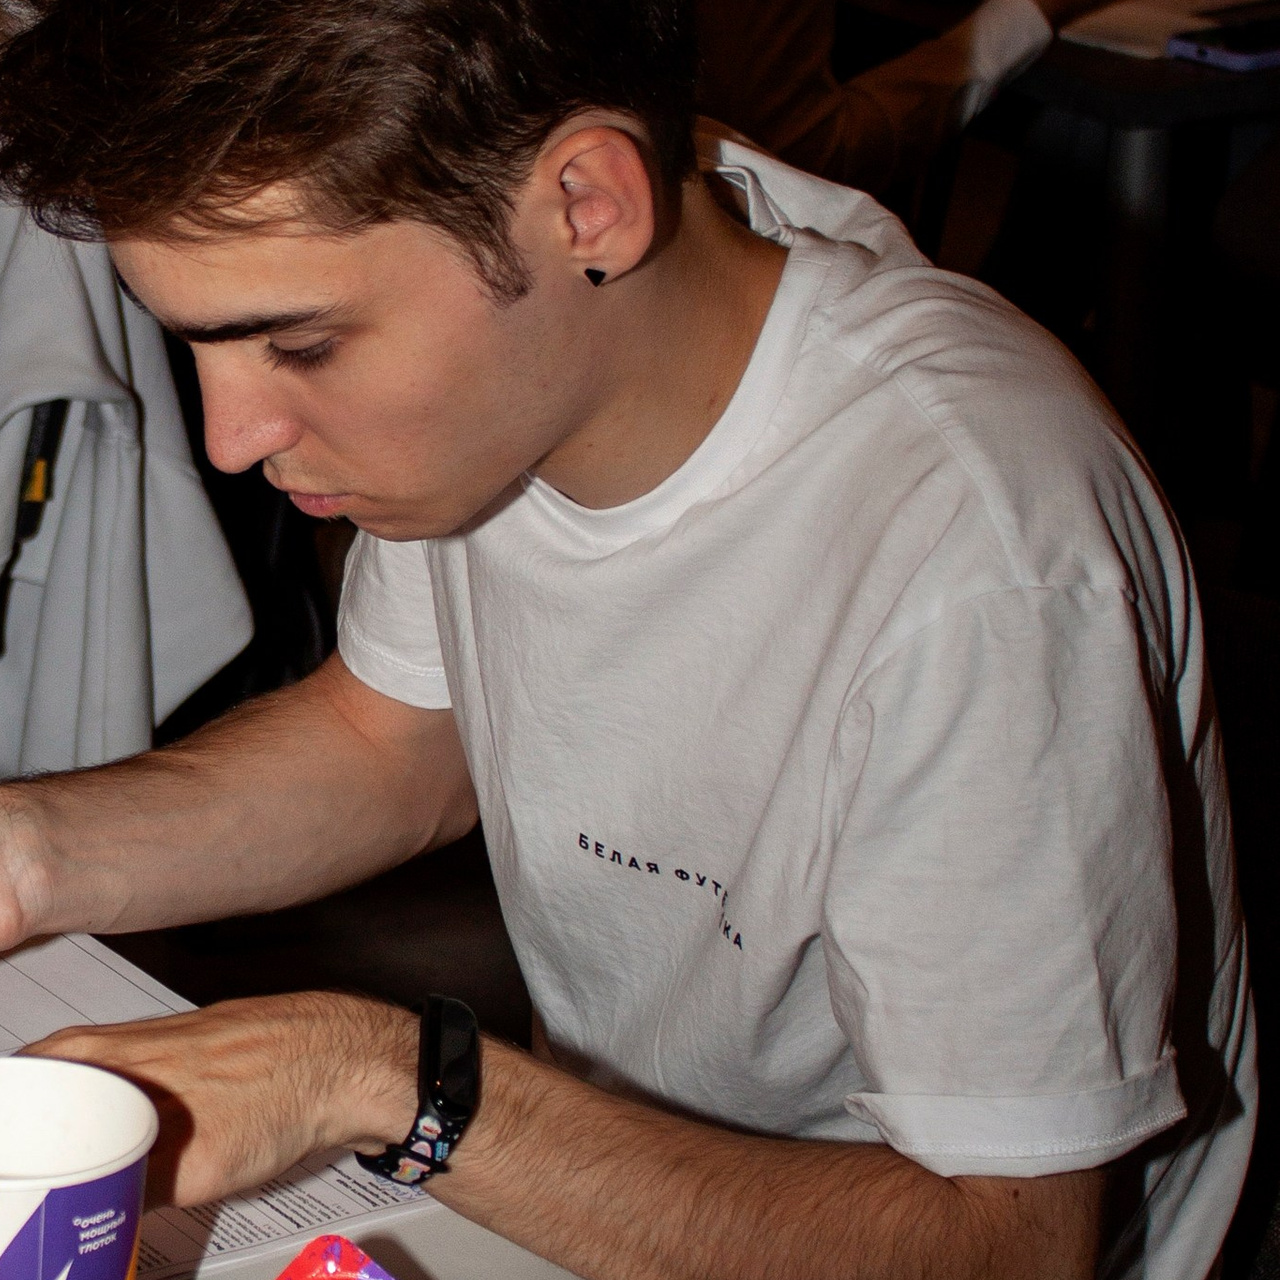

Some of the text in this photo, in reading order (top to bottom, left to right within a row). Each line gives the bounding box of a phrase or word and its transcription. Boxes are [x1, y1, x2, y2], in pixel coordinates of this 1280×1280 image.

[577, 832, 661, 875] БЕЛАЯ
[79, 1211, 127, 1242] мощный
[78, 1232, 117, 1255] глоток
